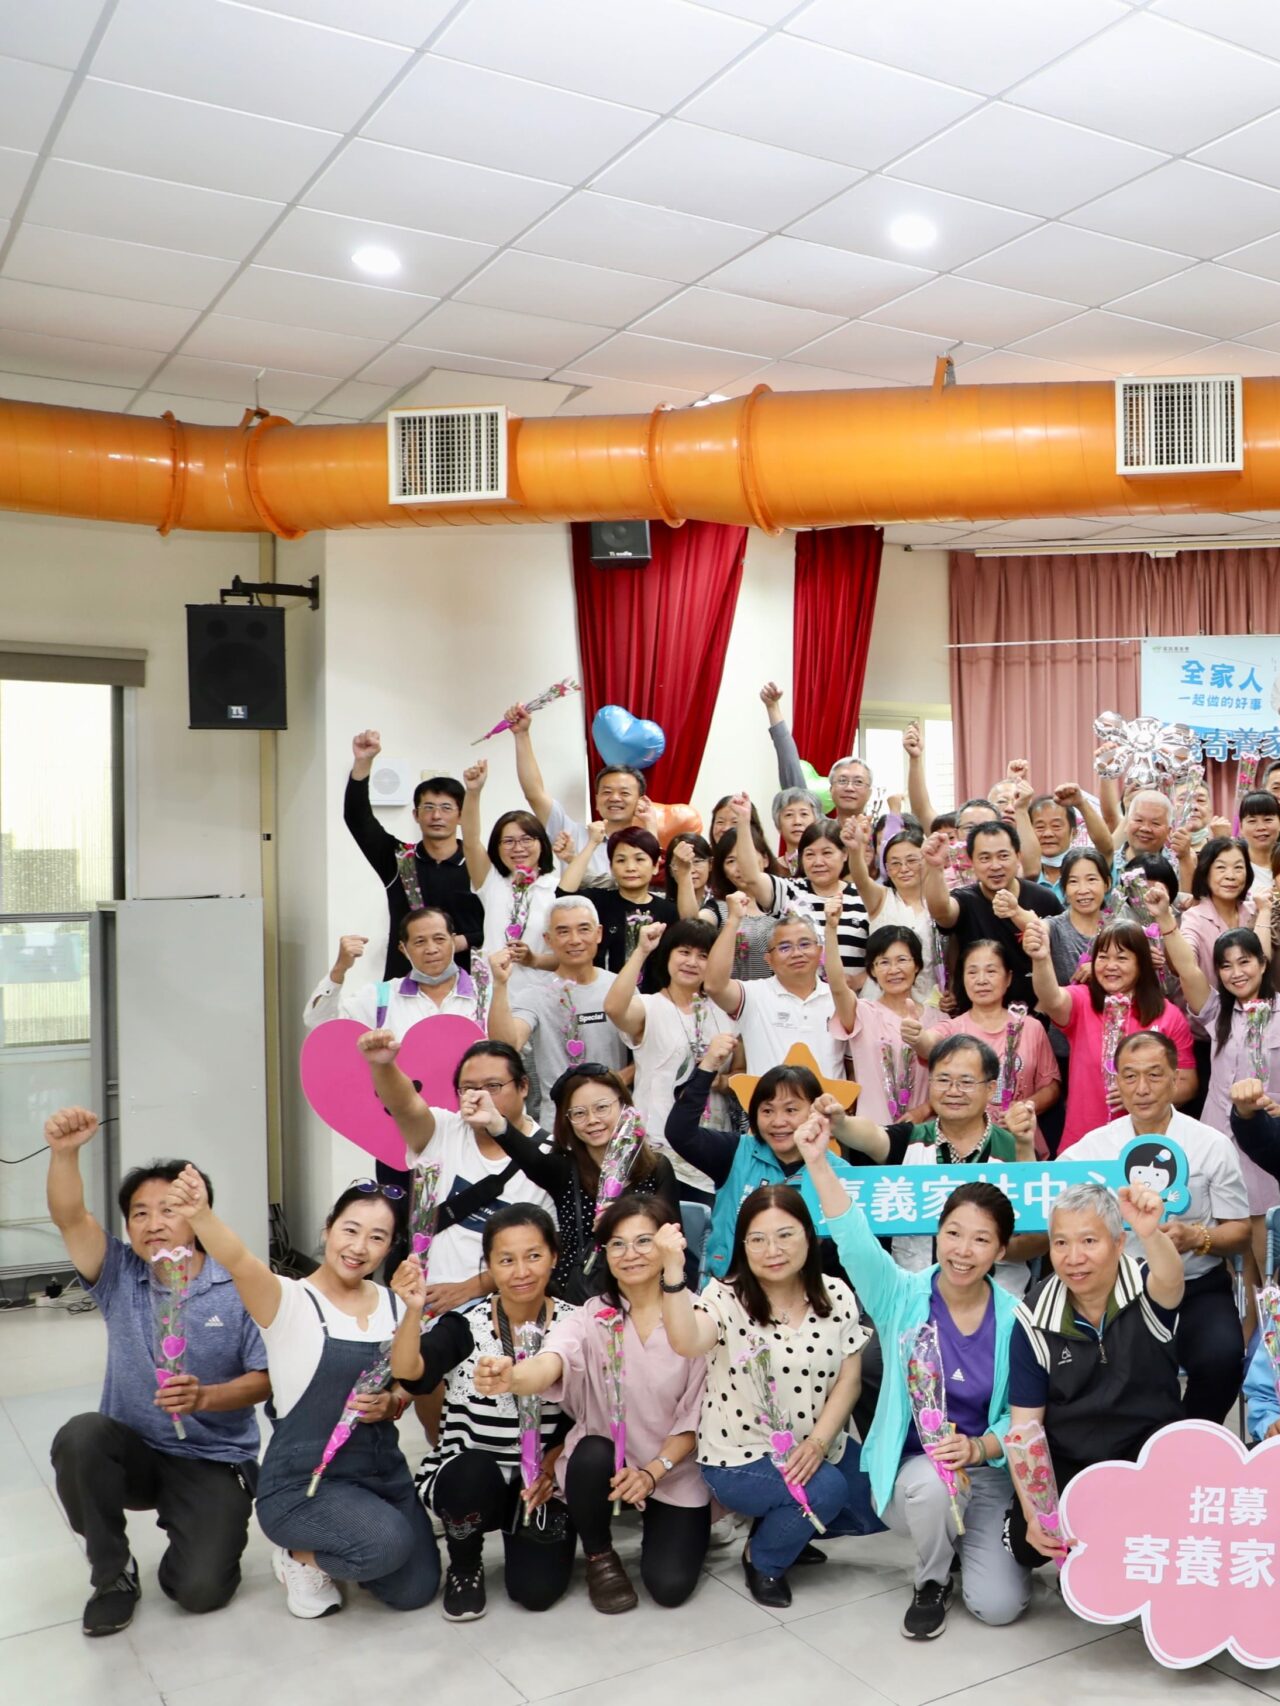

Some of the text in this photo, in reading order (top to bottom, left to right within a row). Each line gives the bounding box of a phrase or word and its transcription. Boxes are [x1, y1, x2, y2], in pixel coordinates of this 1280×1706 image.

[1180, 660, 1263, 693] 全家人
[1178, 693, 1262, 710] 一起做的好事
[579, 1013, 604, 1023] Special
[1189, 1485, 1268, 1526] 招募
